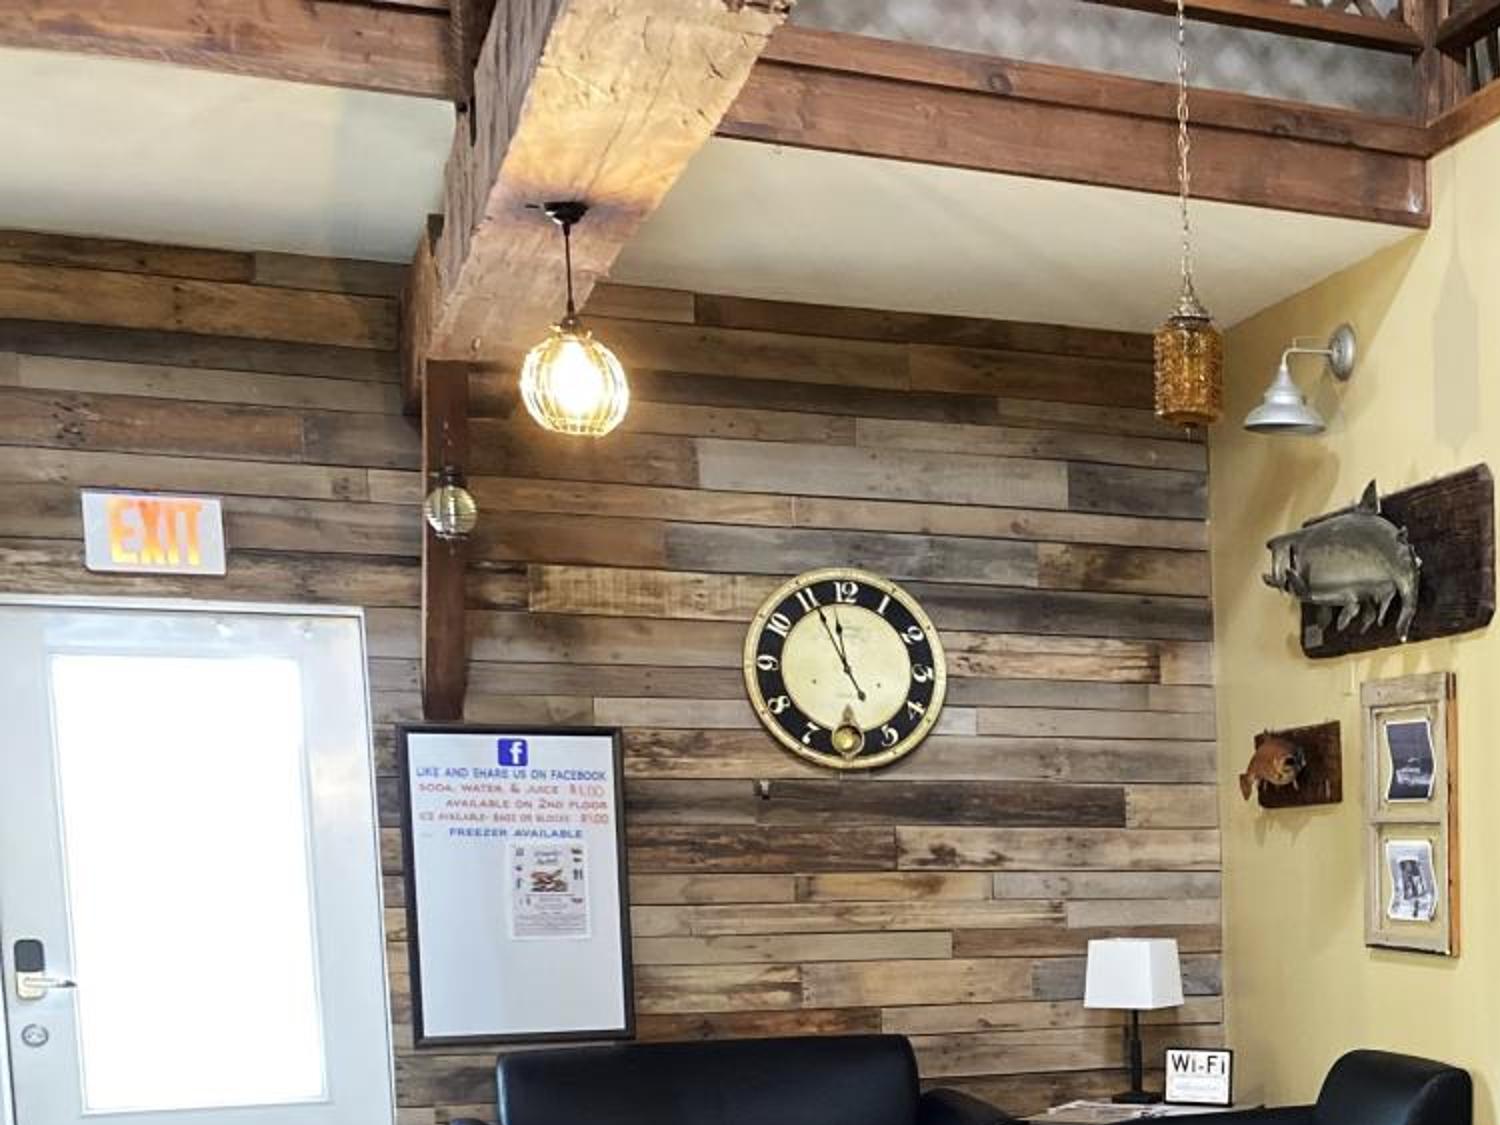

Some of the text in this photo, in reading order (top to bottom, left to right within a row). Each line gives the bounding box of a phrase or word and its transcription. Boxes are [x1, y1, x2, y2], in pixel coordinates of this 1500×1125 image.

[108, 498, 202, 566] EXIT
[796, 587, 820, 611] 11
[834, 581, 859, 604] 12
[877, 594, 891, 615] 1
[766, 613, 791, 638] 10
[902, 625, 925, 645] 2
[757, 655, 778, 671] 9
[911, 663, 934, 683] 3
[768, 695, 791, 715] 8
[907, 700, 925, 720] 4
[802, 722, 820, 744] 7
[881, 725, 899, 747] 5
[416, 767, 607, 781] LIKE AND SHARE US ON FACEBOOK
[461, 783, 502, 793] WATER
[510, 783, 520, 793] &
[527, 784, 559, 794] JUICE
[446, 797, 608, 810] AVAILABLE ON 2ND FLOOR
[449, 827, 583, 839] FREEZER AVAILABLE
[1171, 1053, 1225, 1075] Wi-Fi
